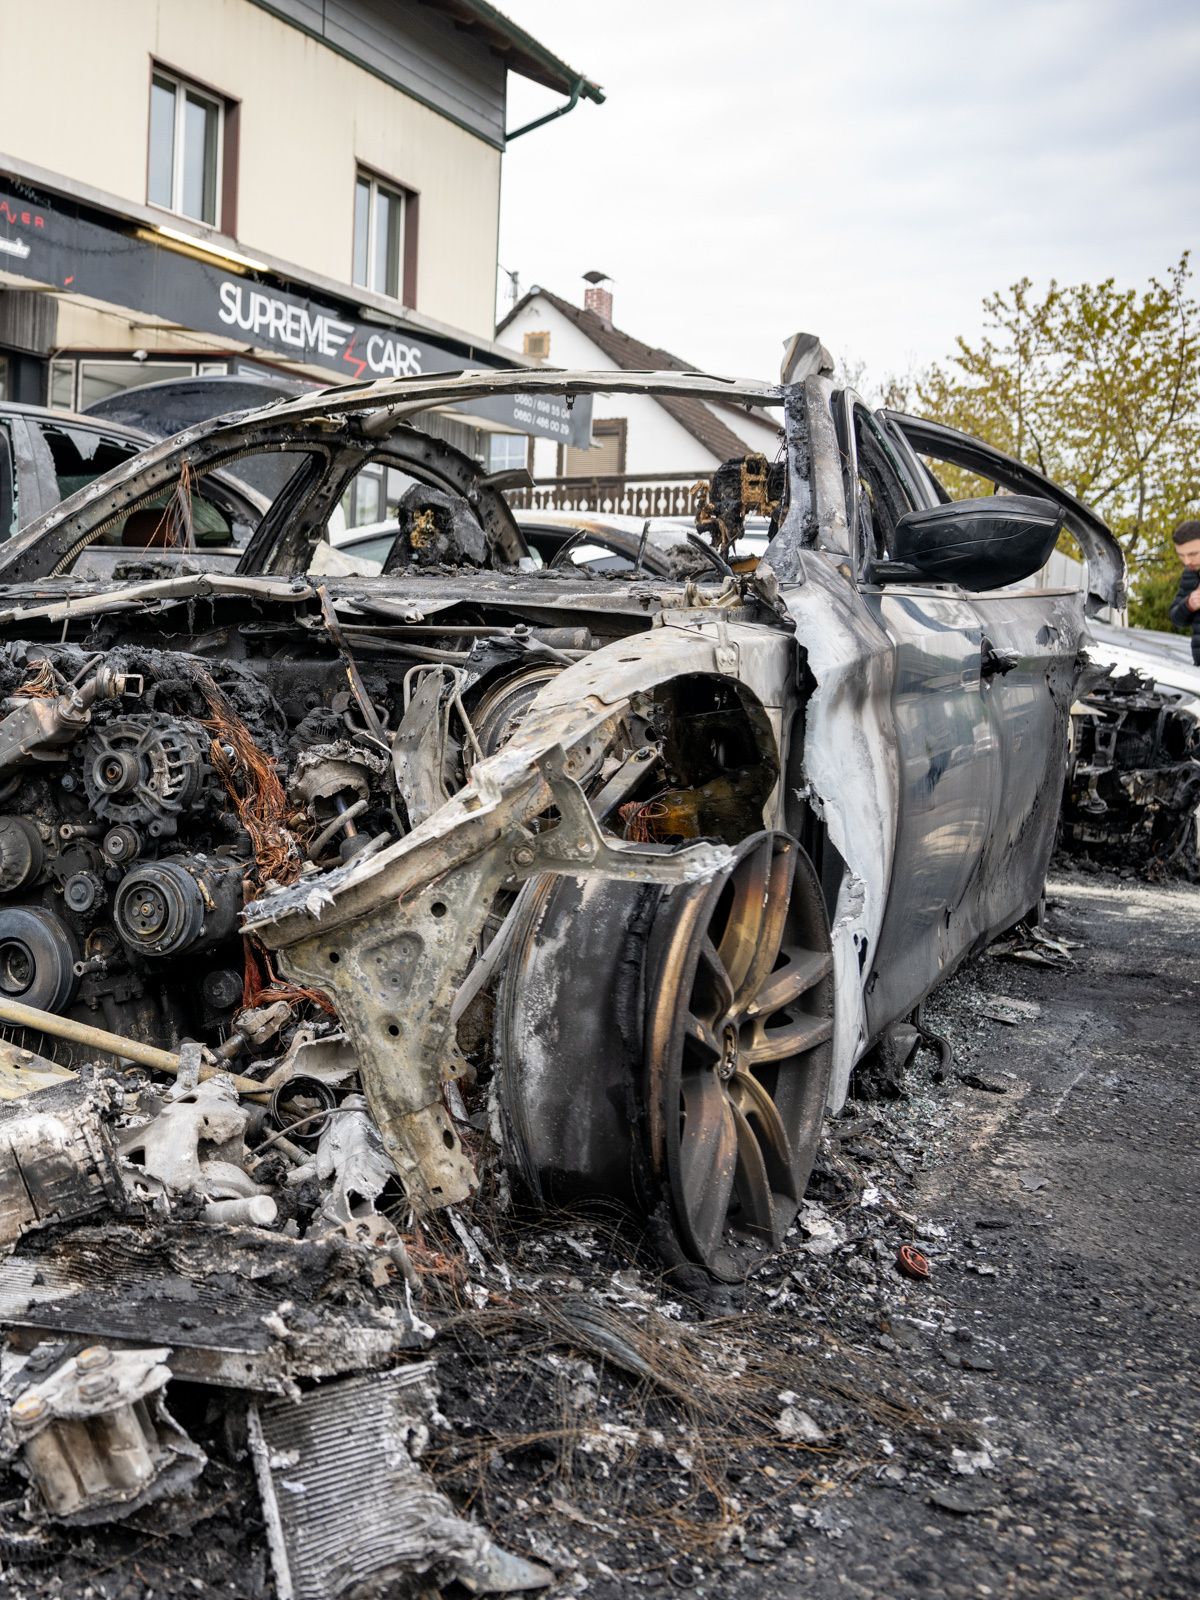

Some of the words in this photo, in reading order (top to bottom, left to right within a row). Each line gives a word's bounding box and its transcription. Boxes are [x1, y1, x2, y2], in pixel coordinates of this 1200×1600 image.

[218, 281, 355, 357] SUPREME
[366, 334, 422, 376] CARS
[550, 420, 560, 432] 00
